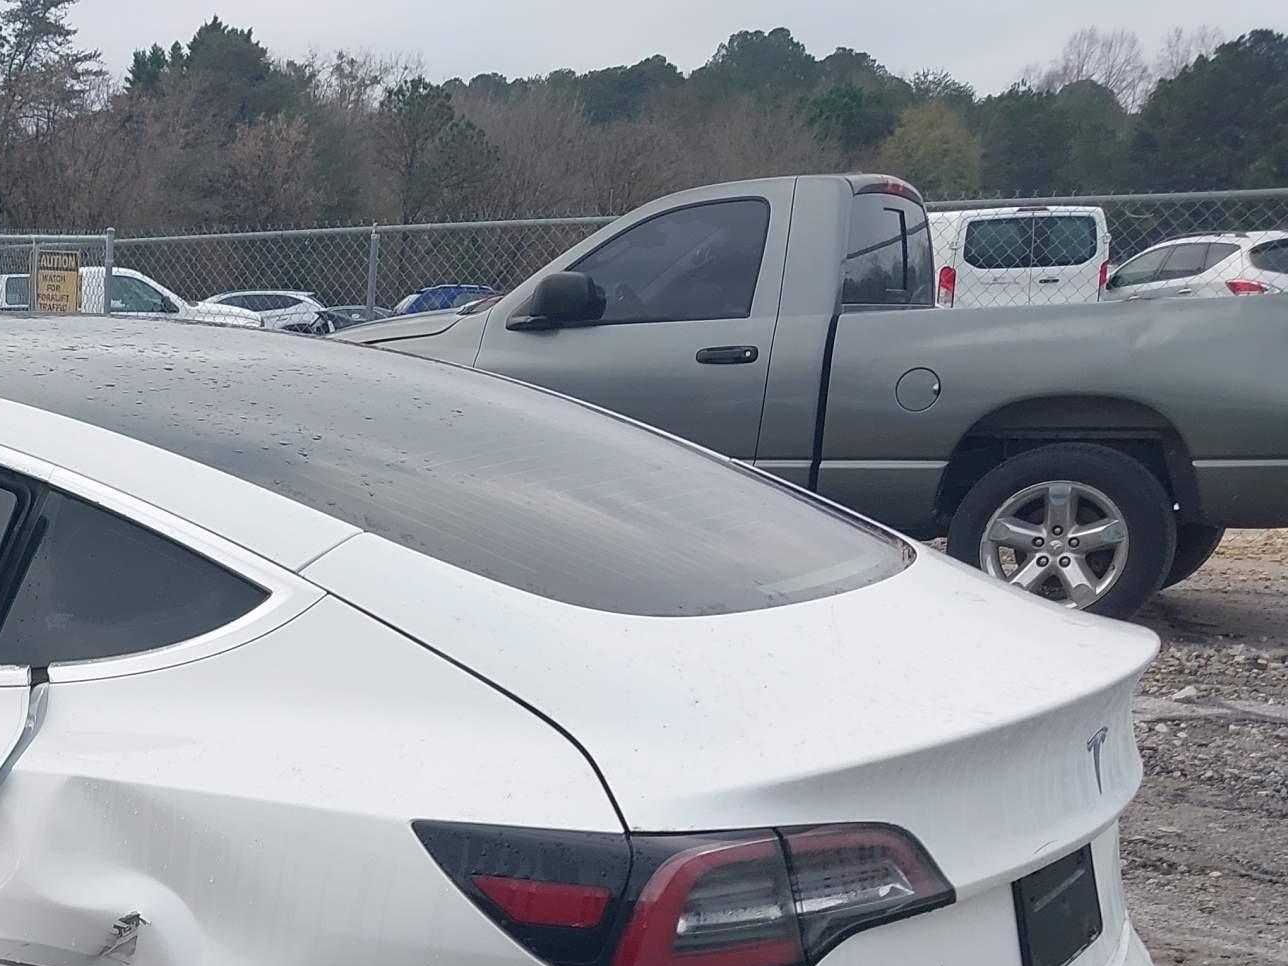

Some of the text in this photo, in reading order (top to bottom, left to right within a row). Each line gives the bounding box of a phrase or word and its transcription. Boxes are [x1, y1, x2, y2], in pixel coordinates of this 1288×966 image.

[40, 254, 76, 268] AUTION
[42, 274, 66, 282] WATCH
[47, 284, 61, 292] FOR
[40, 303, 67, 312] TRAFFIC
